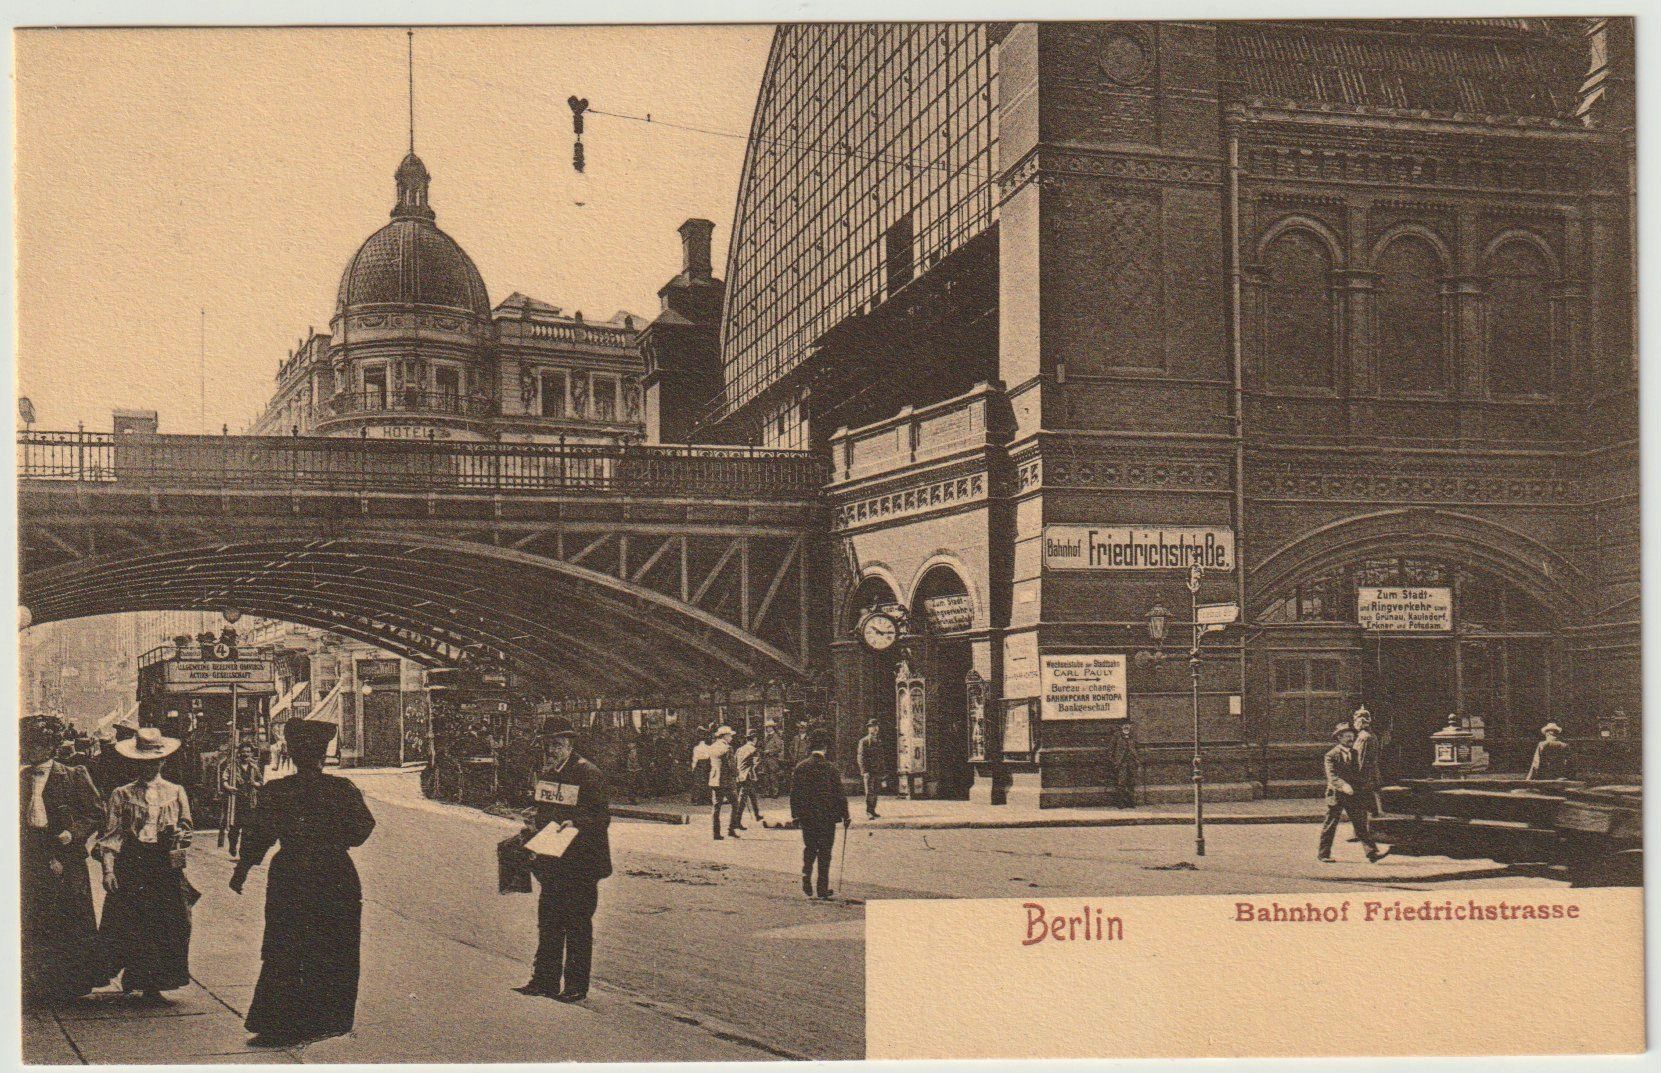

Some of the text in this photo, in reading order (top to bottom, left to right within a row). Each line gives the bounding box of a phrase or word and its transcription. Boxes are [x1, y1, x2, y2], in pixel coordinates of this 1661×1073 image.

[383, 426, 428, 438] HOTEL
[1047, 538, 1081, 558] Bahnhof
[1377, 589, 1433, 600] Zum Stadt-
[1371, 601, 1432, 613] Ringverkehr
[1366, 621, 1394, 630] Erkner
[216, 644, 227, 656] 4
[1053, 669, 1114, 677] CARL PAULY
[1051, 684, 1080, 692] Bureau
[1088, 684, 1116, 692] change
